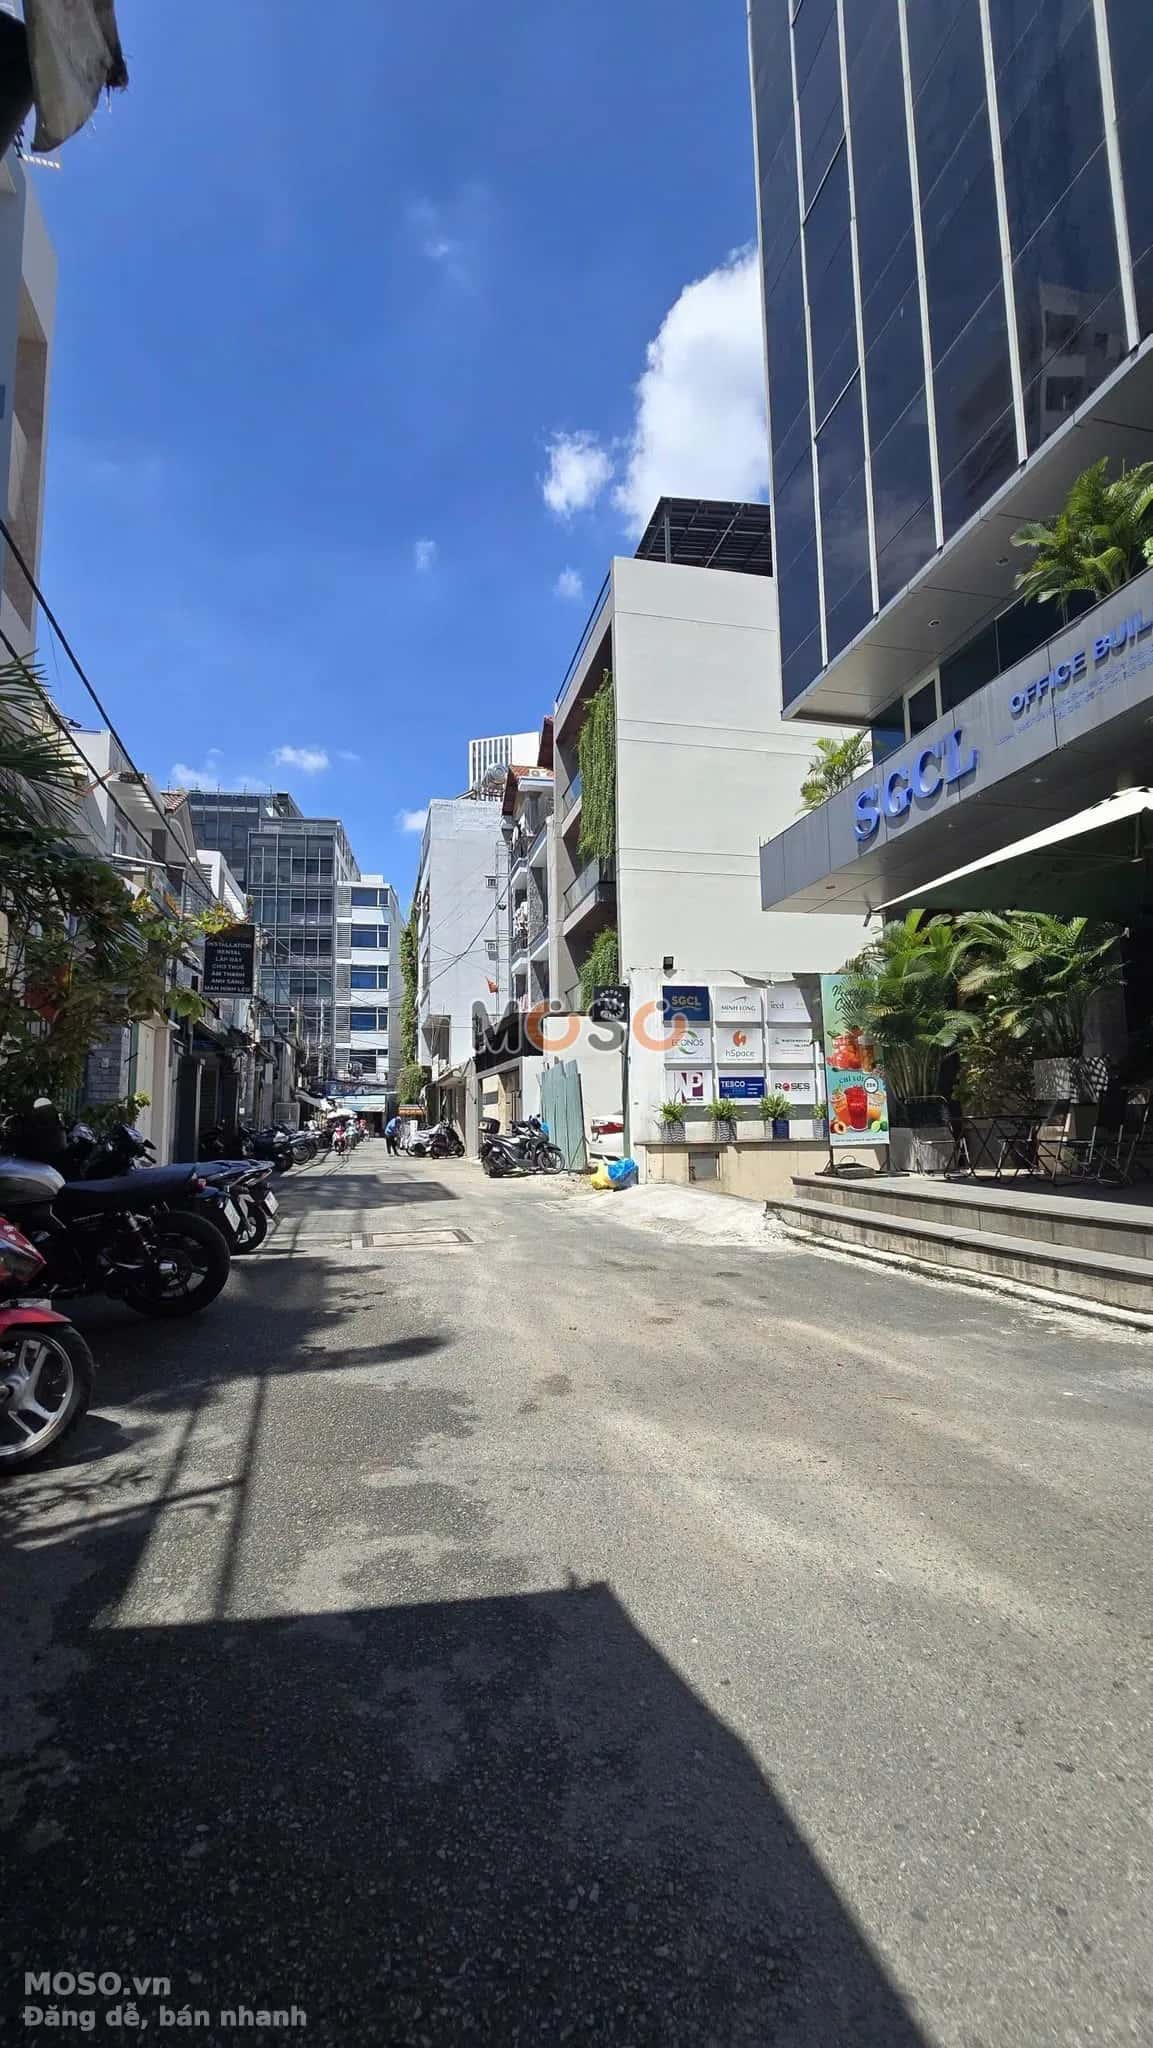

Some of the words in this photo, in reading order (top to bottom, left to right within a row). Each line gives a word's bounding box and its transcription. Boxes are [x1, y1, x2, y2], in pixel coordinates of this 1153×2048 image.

[1008, 648, 1086, 713] OFFICE
[1093, 602, 1153, 662] BUIL
[854, 728, 977, 841] SGCL
[725, 1049, 755, 1058] hSpace
[721, 1080, 746, 1088] TESCO
